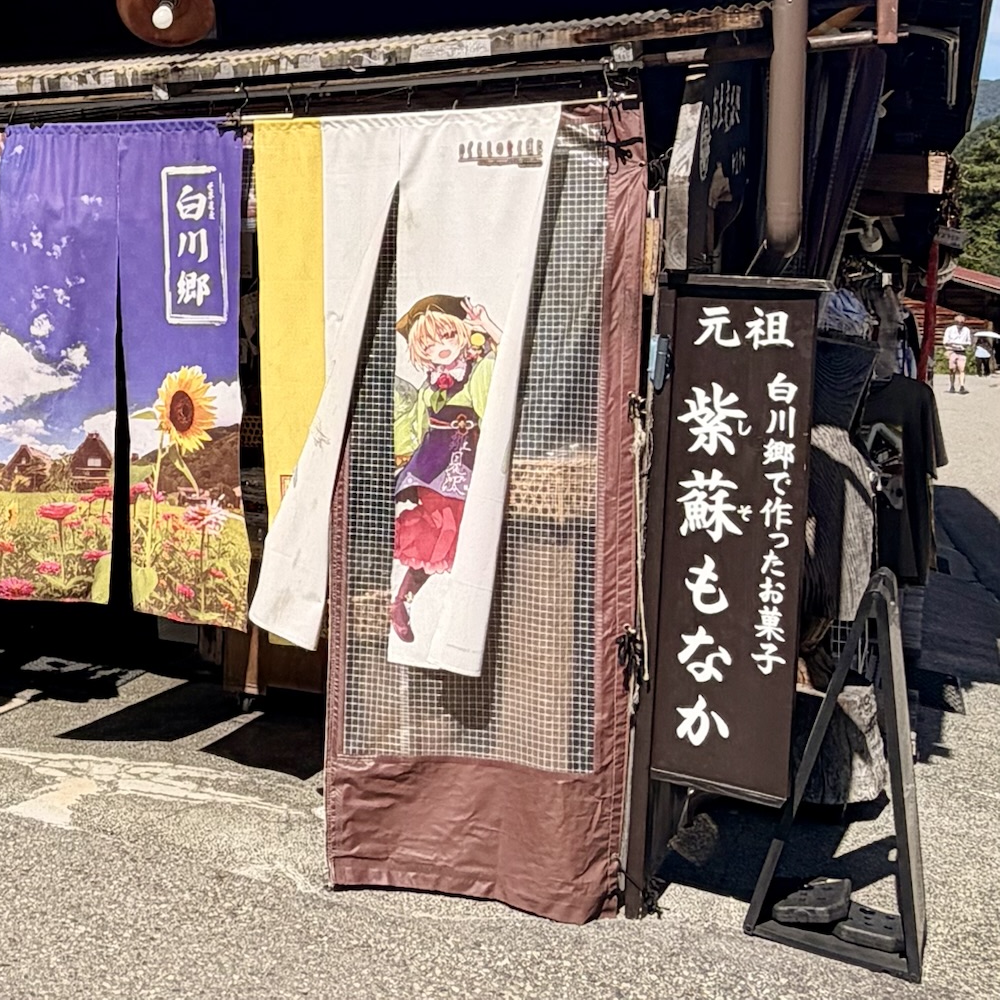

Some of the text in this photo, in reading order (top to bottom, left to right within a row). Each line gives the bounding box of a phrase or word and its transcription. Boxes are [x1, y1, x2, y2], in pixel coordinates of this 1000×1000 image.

[176, 184, 211, 307] 白川郷
[694, 305, 795, 350] 元祖
[676, 382, 747, 746] 紫蘇もなか
[751, 373, 799, 675] 白川郷で作ったお菓子
